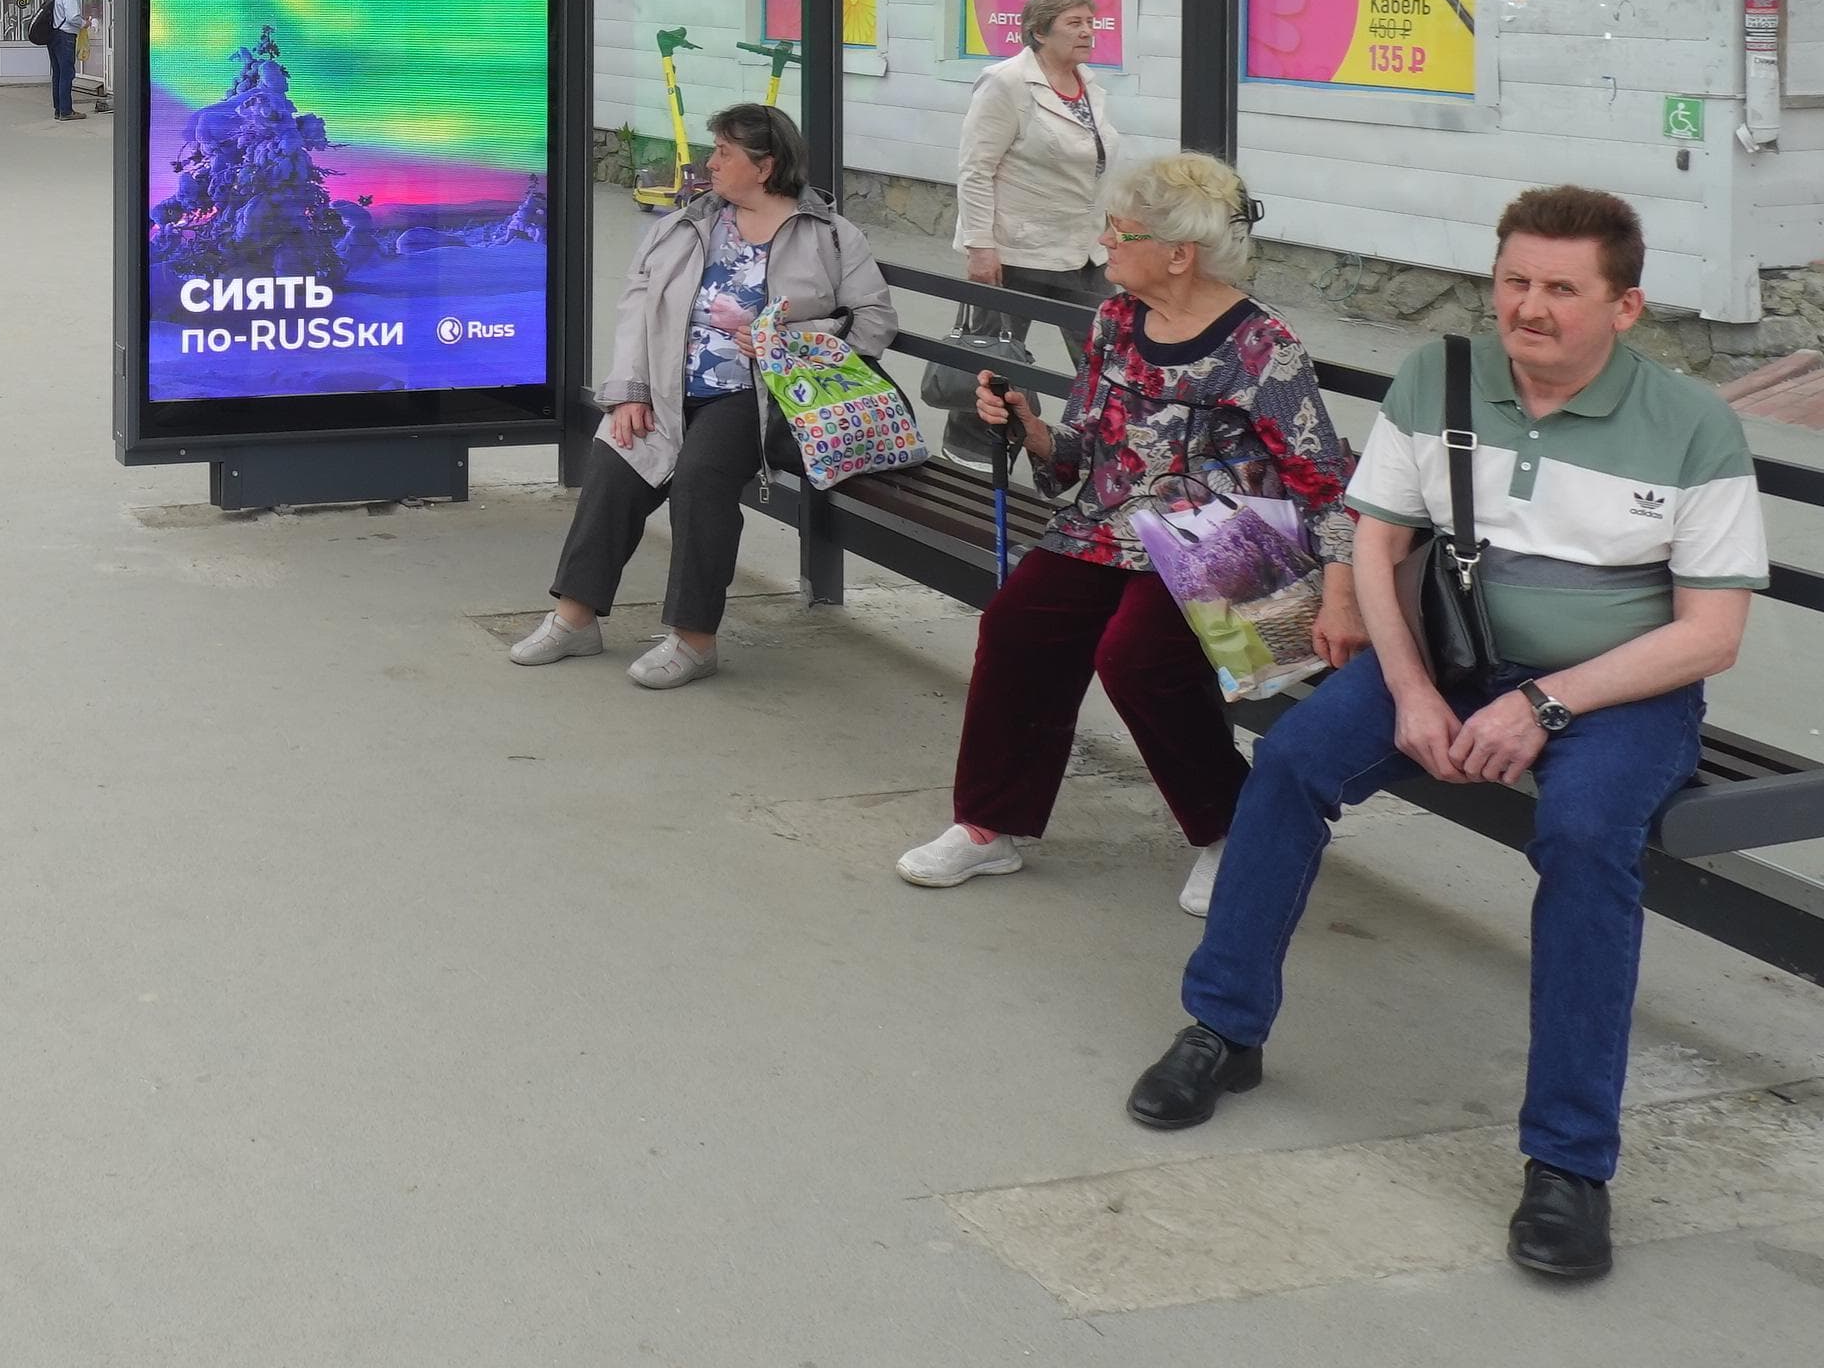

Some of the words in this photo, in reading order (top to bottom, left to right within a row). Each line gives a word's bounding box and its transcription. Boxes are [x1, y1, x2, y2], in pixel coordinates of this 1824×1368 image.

[1369, 44, 1404, 73] 135
[181, 316, 404, 354] по-RUSSки
[467, 321, 516, 340] Russ
